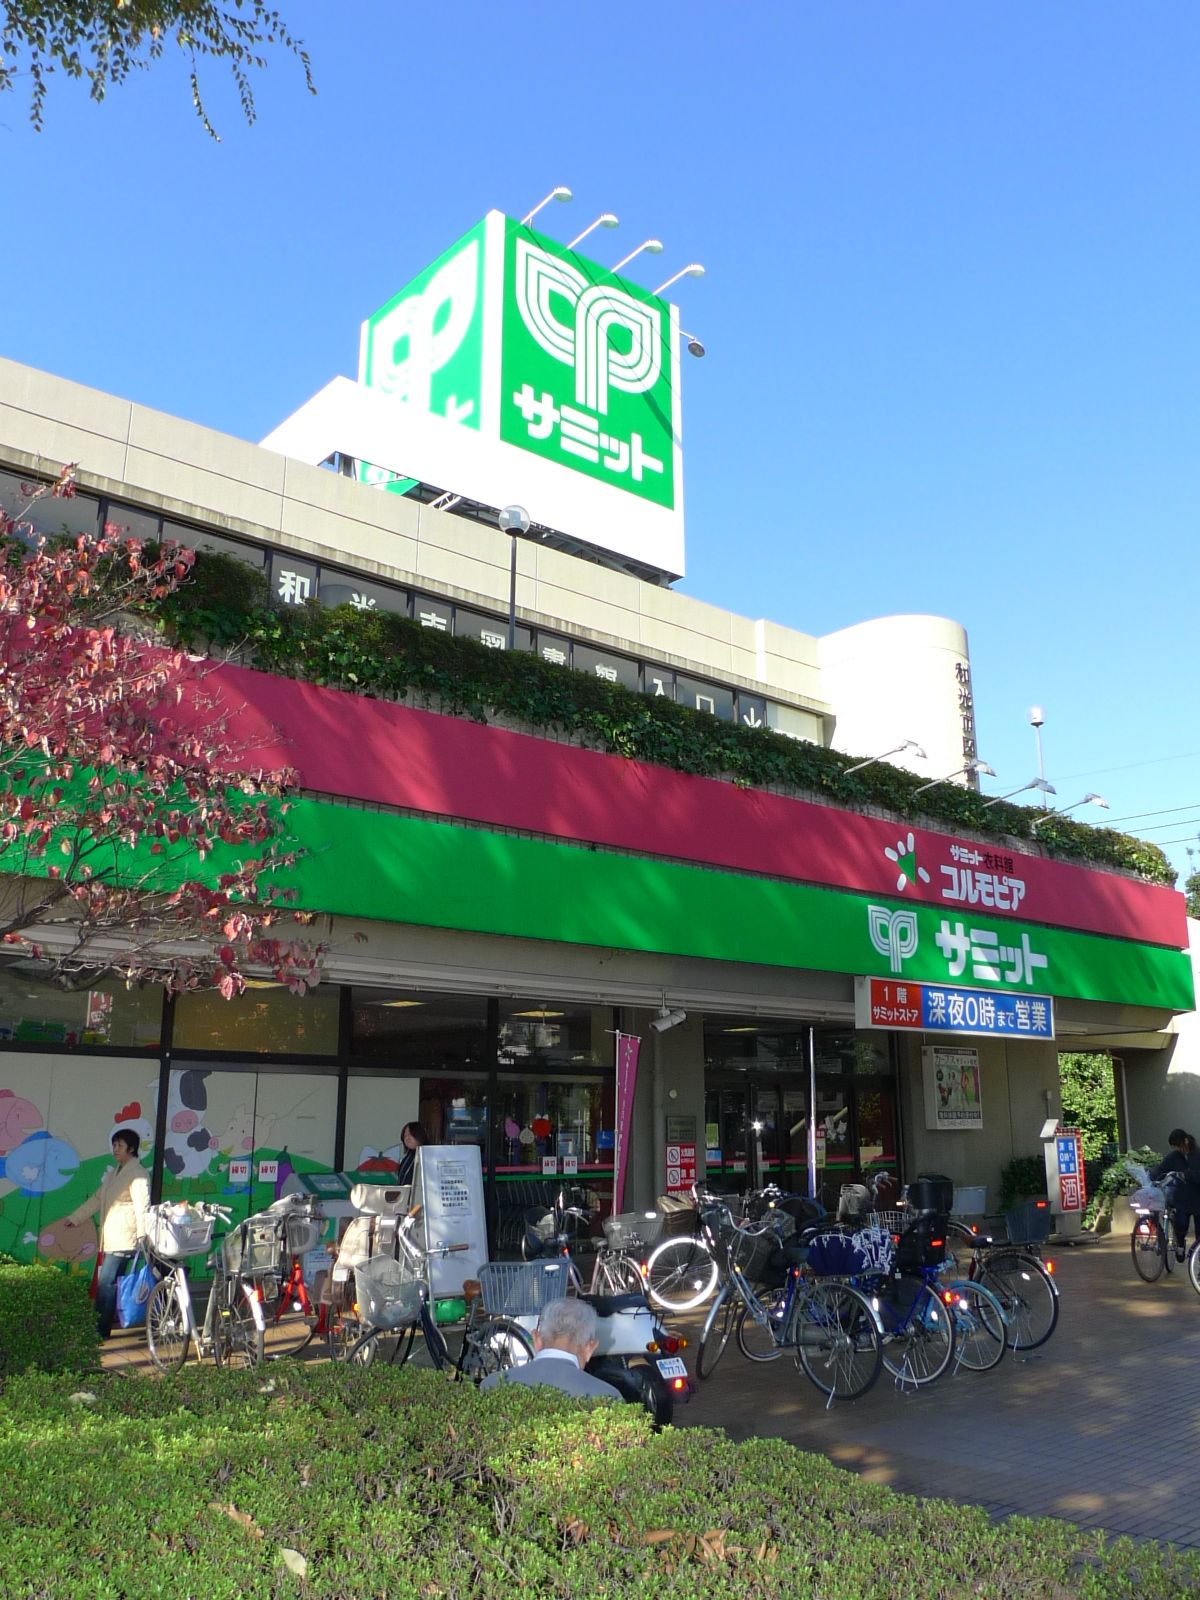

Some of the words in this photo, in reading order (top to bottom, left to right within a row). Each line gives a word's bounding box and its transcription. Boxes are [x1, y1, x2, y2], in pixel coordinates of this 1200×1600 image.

[513, 384, 663, 481] サミット
[940, 865, 1025, 911] コルモピア
[935, 919, 1048, 985] サミット
[872, 1006, 918, 1023] サミットストア
[883, 986, 907, 1004] 1階
[928, 991, 1047, 1032] 深夜0時まで営業
[1061, 1178, 1078, 1207] 酒
